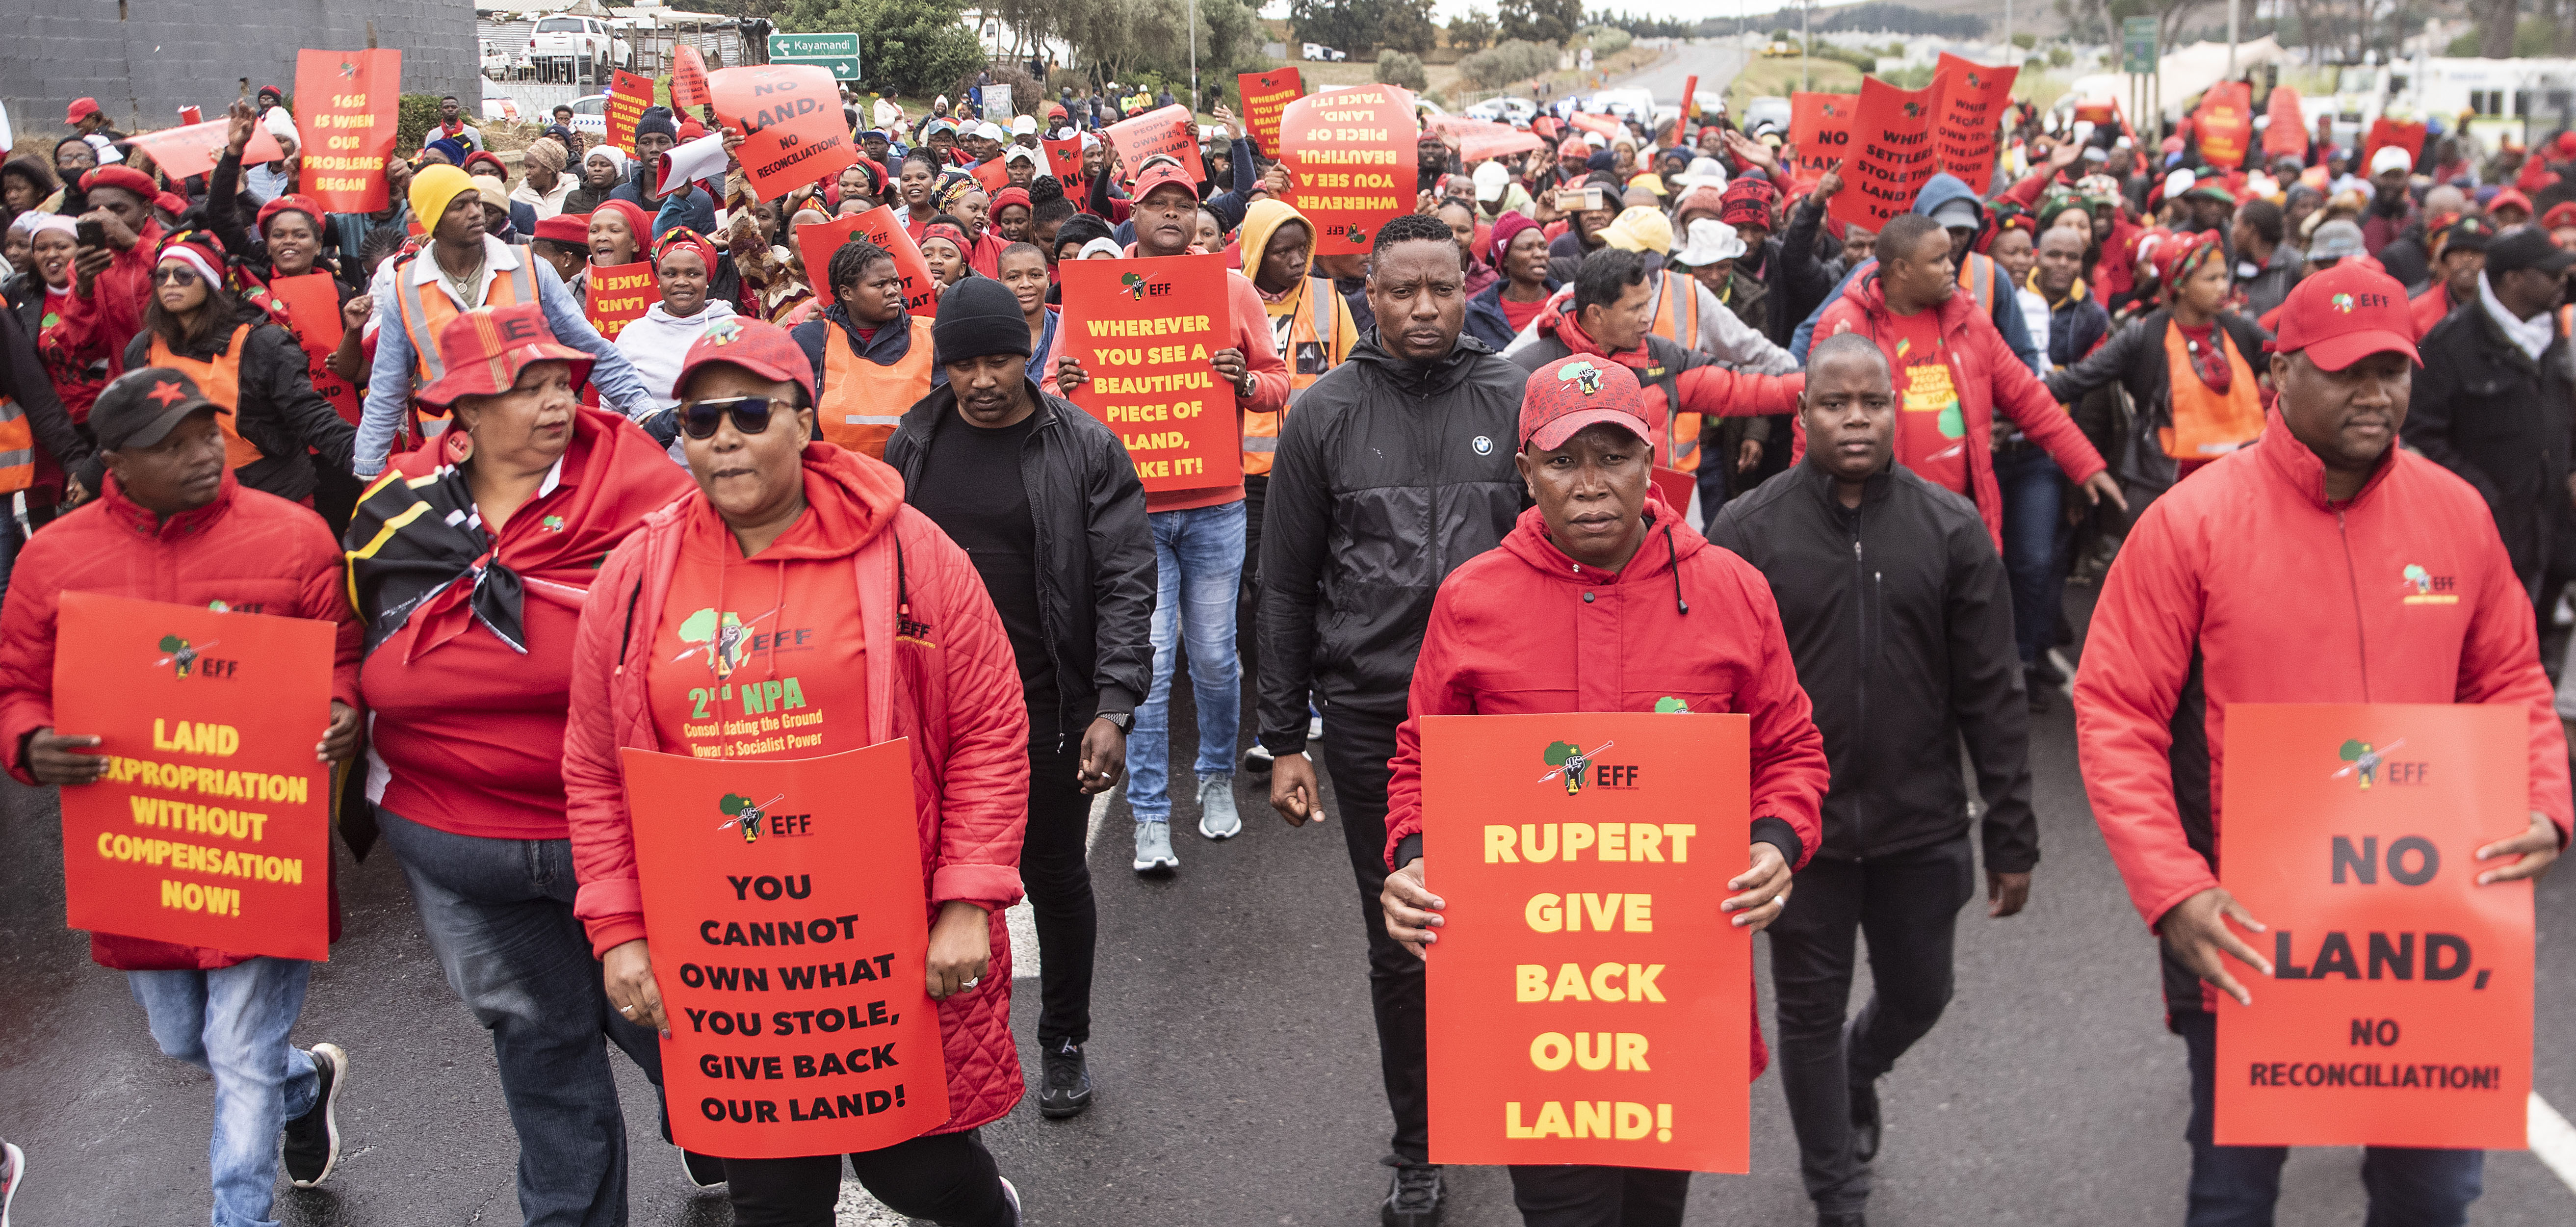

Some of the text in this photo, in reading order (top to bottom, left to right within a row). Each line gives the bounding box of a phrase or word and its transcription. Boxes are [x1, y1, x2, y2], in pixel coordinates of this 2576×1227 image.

[794, 40, 850, 51] Kayamandi
[611, 91, 647, 107] WHEREVER
[755, 82, 798, 96] NO
[1249, 89, 1296, 104] WHEREVER
[332, 93, 366, 108] 1652
[612, 101, 627, 111] YOU
[629, 106, 640, 115] SEE
[1253, 106, 1272, 114] YOU
[1311, 93, 1385, 108] TAKE IT!
[314, 114, 374, 129] IS WHEN
[740, 98, 825, 136] LAND,
[1320, 110, 1374, 121] LAND,
[1949, 113, 1985, 127] PEOPLE
[1133, 120, 1170, 136] PEOPLE
[1307, 129, 1387, 141] PIECE OF
[1819, 131, 1848, 145] NO
[1939, 126, 1966, 141] OWN
[328, 135, 360, 150] OUR
[622, 134, 635, 143] LAN
[779, 134, 799, 150] NO
[1132, 129, 1180, 148] OWN 72%
[757, 135, 840, 179] RECONCILIATION!
[1131, 140, 1189, 162] OF THE LAND
[1297, 150, 1397, 164] BEAUTIFUL
[1945, 144, 1965, 157] THE
[303, 156, 384, 170] PROBLEMS
[1801, 156, 1841, 170] LAN
[1858, 159, 1933, 183] STOLE THE
[315, 177, 366, 191] BEGAN
[1300, 174, 1395, 188] YOU SEE A
[1861, 181, 1906, 202] LAND
[1297, 196, 1398, 209] WHEREVER
[872, 232, 888, 244] EFF
[1327, 226, 1344, 235] EFF
[608, 273, 651, 290] TAKE
[1149, 283, 1171, 295] EFF
[595, 296, 644, 312] LAND,
[2361, 293, 2388, 307] EFF
[1087, 315, 1210, 337] WHEREVER
[1093, 343, 1208, 365] YOU SEE A
[1907, 351, 1935, 366] 3rd
[1094, 372, 1213, 394] BEAUTIFUL
[1107, 401, 1203, 423] PIECE OF
[1124, 432, 1190, 451] LAND,
[1133, 457, 1203, 478] KE IT!
[900, 620, 931, 638] EFF
[754, 629, 811, 651] EFF
[203, 658, 238, 677] EFF
[742, 677, 807, 715] NPA
[683, 708, 823, 738] Consoldating the Ground
[153, 718, 239, 756] LAND
[736, 736, 785, 756] Socialist
[786, 733, 822, 749] Power
[101, 756, 308, 803] XPROPRIATION
[1598, 765, 1639, 786] EFF
[2390, 763, 2429, 783] EFF
[130, 796, 267, 841] WITHOUT
[771, 814, 811, 834] EFF
[1484, 822, 1696, 863] RUPERT
[98, 833, 303, 884] COMPENSATION
[2331, 835, 2441, 887] NO
[727, 874, 812, 901] YOU
[161, 880, 240, 916] NOW!
[1525, 893, 1653, 932] GIVE
[700, 914, 859, 946] CANNOT
[2274, 930, 2492, 989] LAND,
[680, 953, 895, 992] OWN WHAT
[1516, 962, 1666, 1002] BACK
[684, 1000, 900, 1037] YOU STOLE,
[2350, 1018, 2400, 1047] NO
[700, 1042, 899, 1080] GIVE BACK
[1530, 1032, 1651, 1071] OUR
[2250, 1063, 2500, 1089] RECONCILIATION!
[701, 1084, 906, 1123] OUR LAND!
[1506, 1100, 1673, 1143] LAND!
